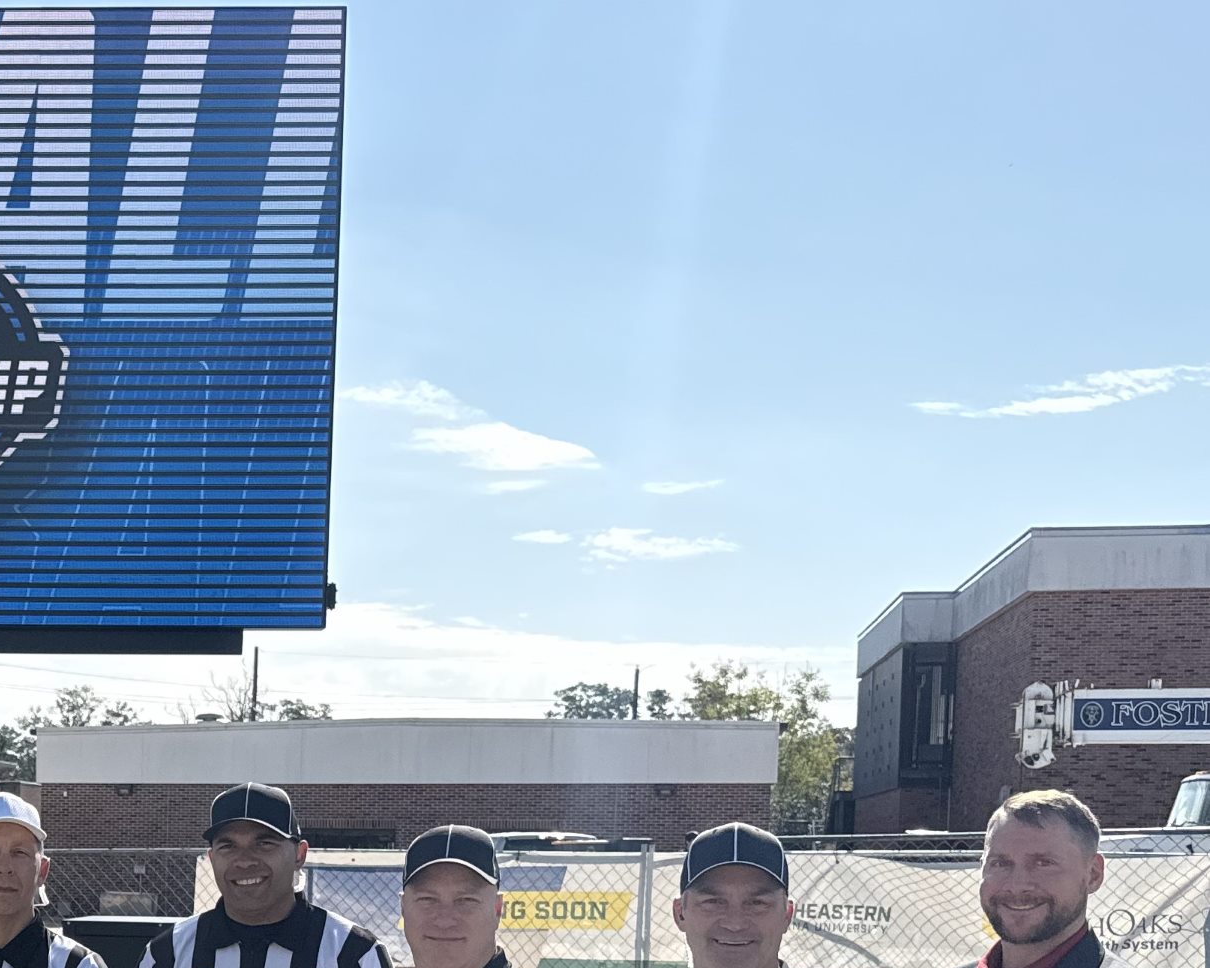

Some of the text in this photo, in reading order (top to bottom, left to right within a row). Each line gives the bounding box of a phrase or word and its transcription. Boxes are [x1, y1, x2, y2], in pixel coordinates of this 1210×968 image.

[1111, 700, 1210, 728] FOST
[535, 900, 609, 921] SOON
[795, 903, 892, 922] HEASTERN
[1122, 938, 1179, 952] System
